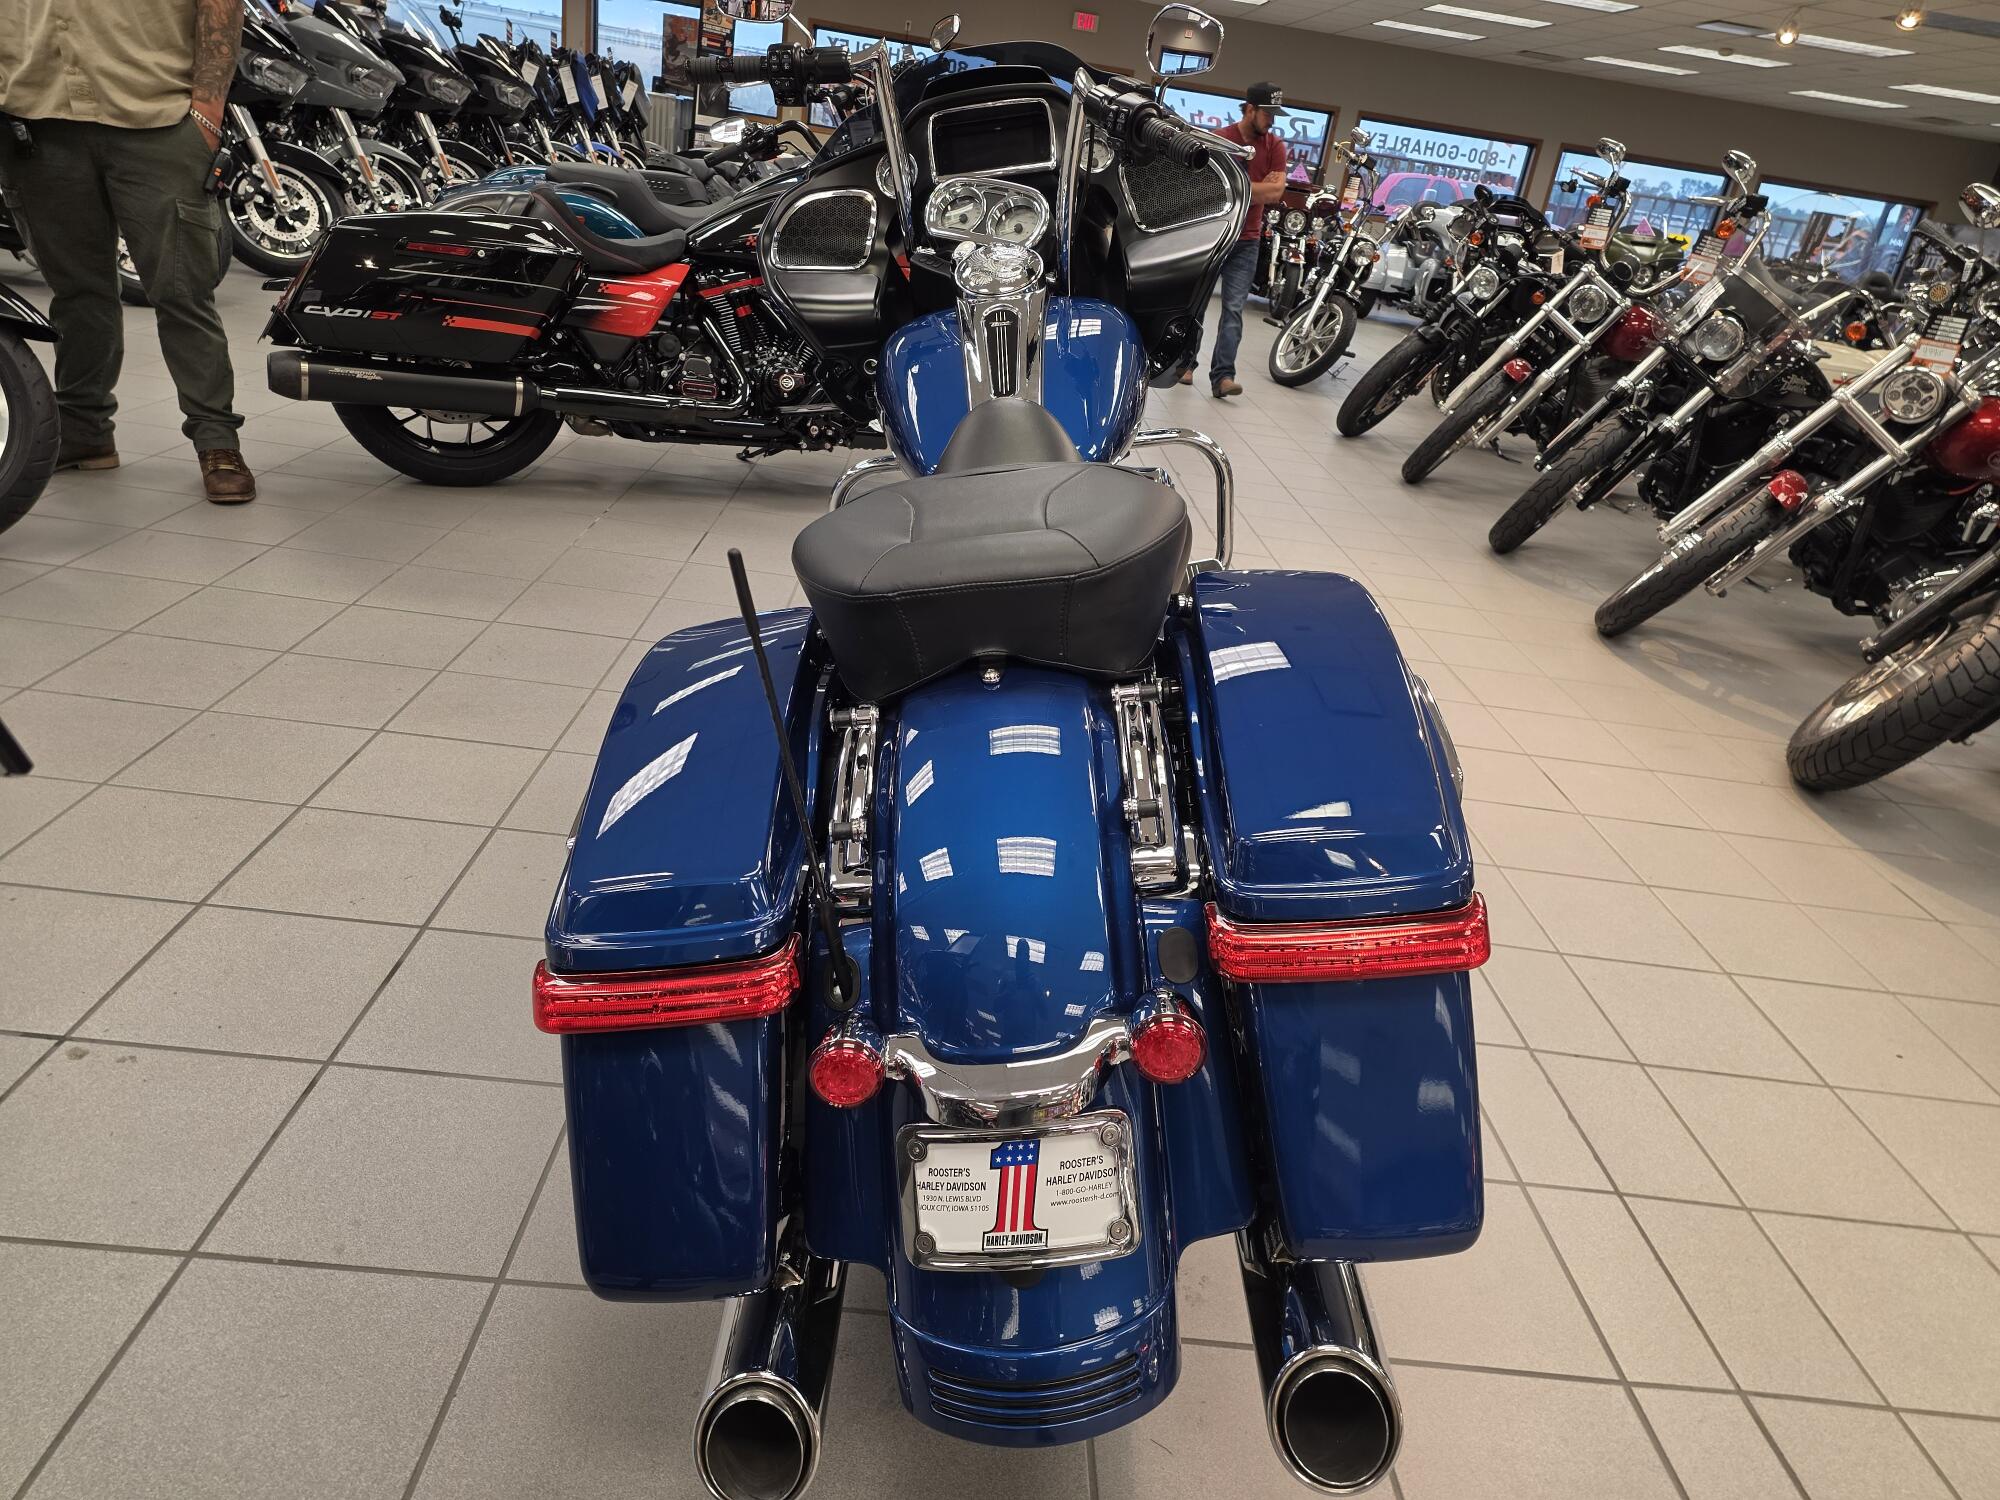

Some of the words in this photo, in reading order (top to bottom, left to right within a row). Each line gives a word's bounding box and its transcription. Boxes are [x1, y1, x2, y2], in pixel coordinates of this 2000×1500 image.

[1076, 13, 1096, 31] EXIT
[1060, 1156, 1104, 1170] ROOSTER'S
[928, 1168, 970, 1177] ROOSTER'S
[1046, 1173, 1078, 1186] HARLEY
[946, 1182, 986, 1191] DAVIDSON
[1056, 1182, 1112, 1196] 1-800-GO-HARLEY
[986, 1233, 1044, 1246] HARLEY-DAVIDSON
